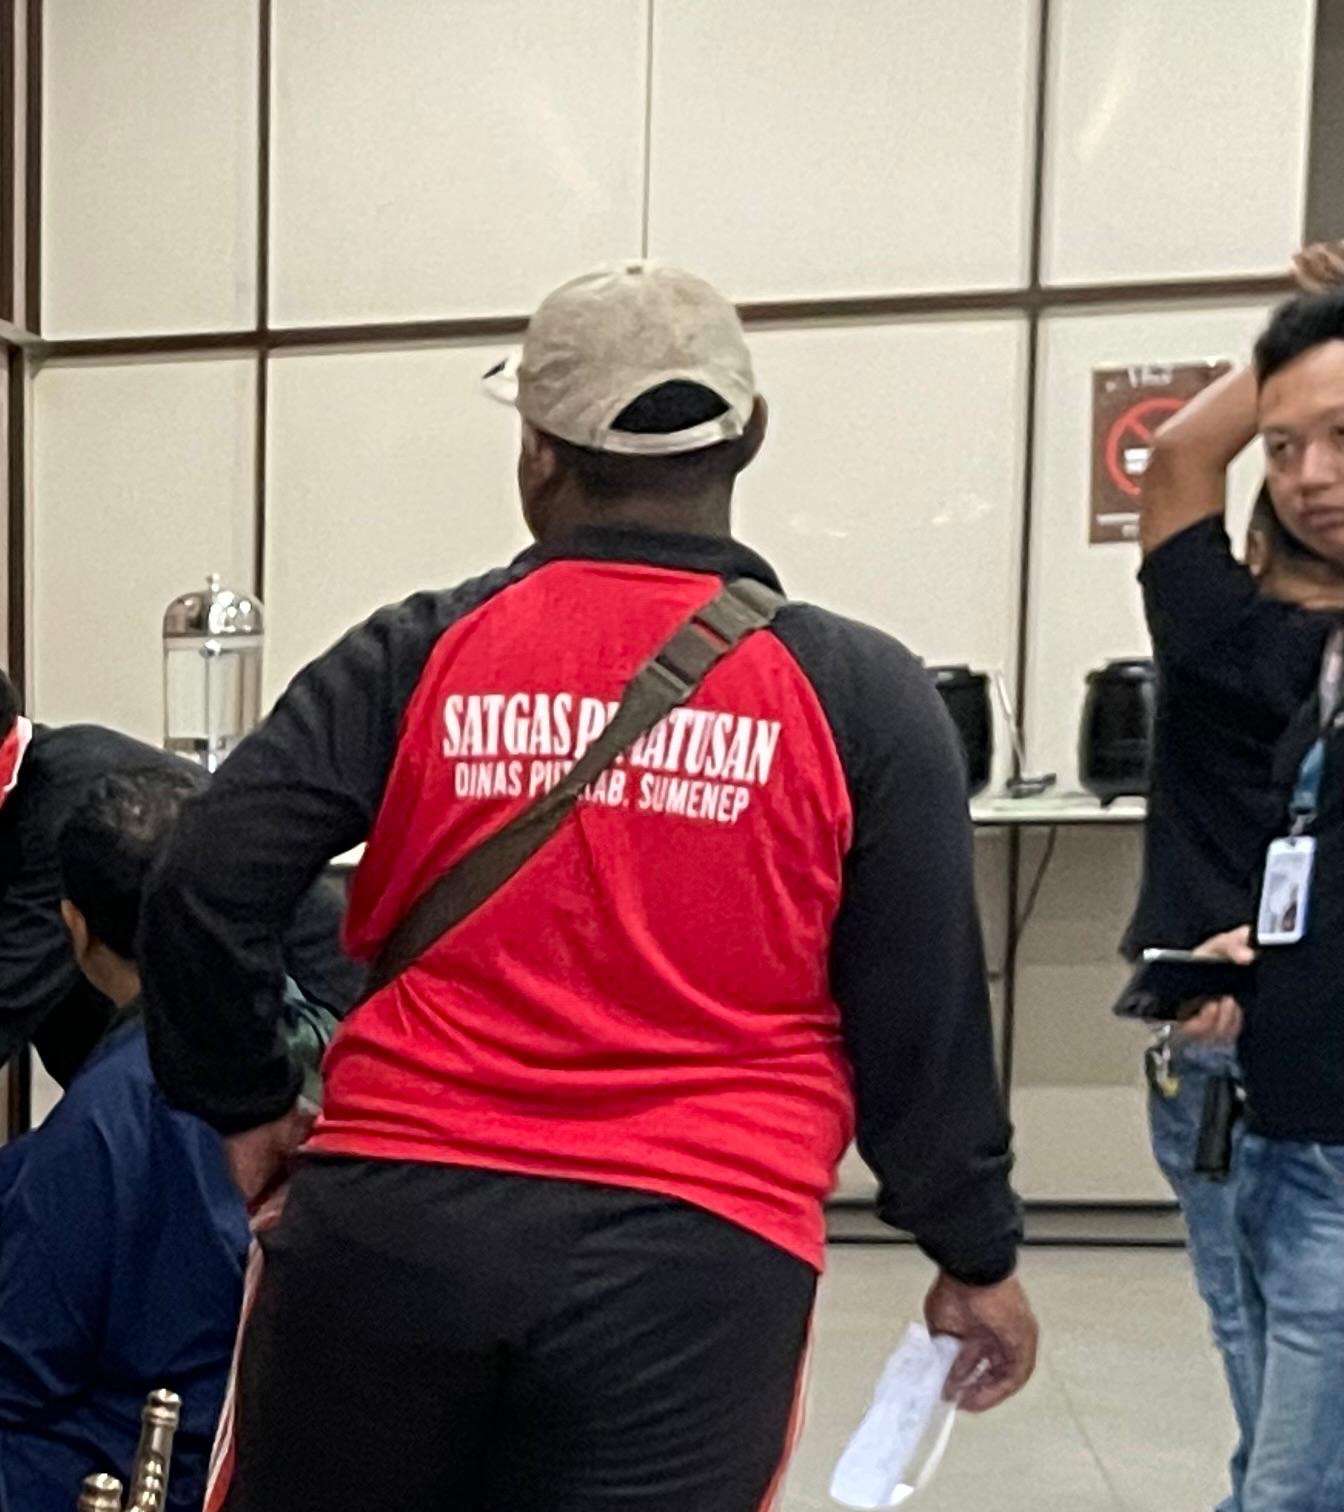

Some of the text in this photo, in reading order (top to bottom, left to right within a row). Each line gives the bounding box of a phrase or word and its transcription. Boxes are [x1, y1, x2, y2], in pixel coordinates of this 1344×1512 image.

[443, 693, 781, 785] SATGAS PATUSAN
[455, 760, 523, 799] DINAS
[639, 772, 749, 824] SUMENEP
